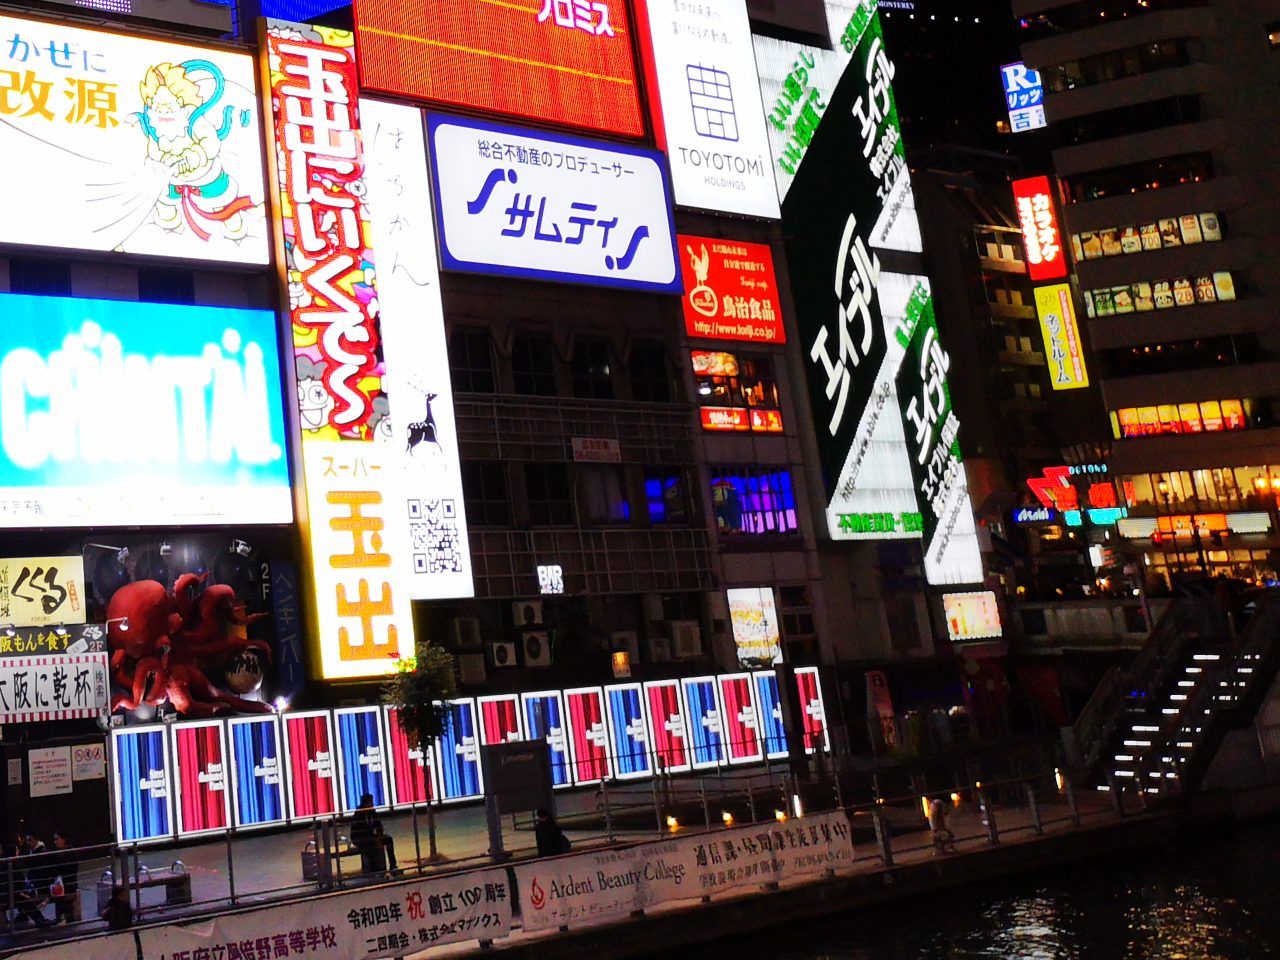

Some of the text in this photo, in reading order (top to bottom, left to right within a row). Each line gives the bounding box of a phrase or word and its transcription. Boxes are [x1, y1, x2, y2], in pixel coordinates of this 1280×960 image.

[7, 33, 106, 73] かぜに
[477, 139, 635, 179] 総合不動産のプロデューサー
[499, 192, 619, 249] サムティ
[1032, 192, 1060, 263] カラオケ
[10, 566, 68, 615] くくる
[325, 490, 401, 662] 玉出
[536, 564, 563, 587] BAR
[89, 640, 104, 653] 2F
[549, 875, 593, 901] Ardent
[597, 868, 643, 892] Beauty
[347, 902, 403, 931] 令和四年
[406, 892, 426, 921] 祝
[160, 923, 338, 960] 府立阿倍野高等学校
